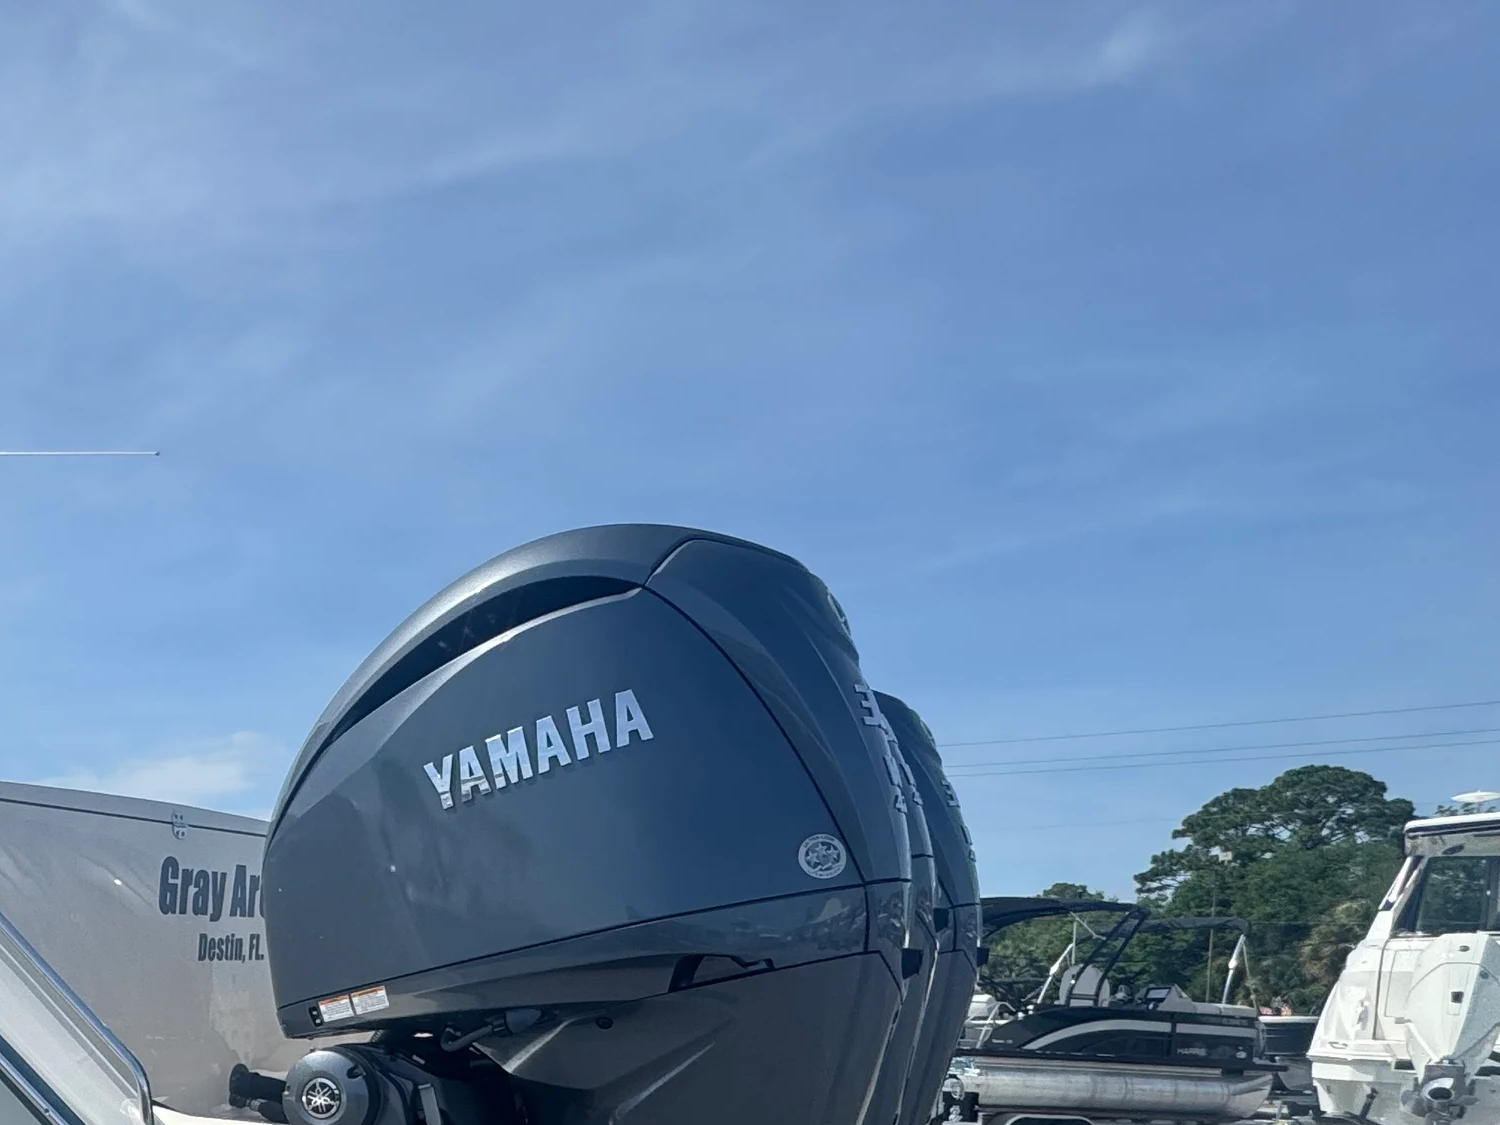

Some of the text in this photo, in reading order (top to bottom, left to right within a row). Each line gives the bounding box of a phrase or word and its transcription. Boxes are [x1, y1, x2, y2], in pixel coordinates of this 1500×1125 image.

[423, 689, 654, 810] YAMAHA
[159, 856, 266, 922] Gray Ar
[198, 933, 264, 963] Destin, FL.
